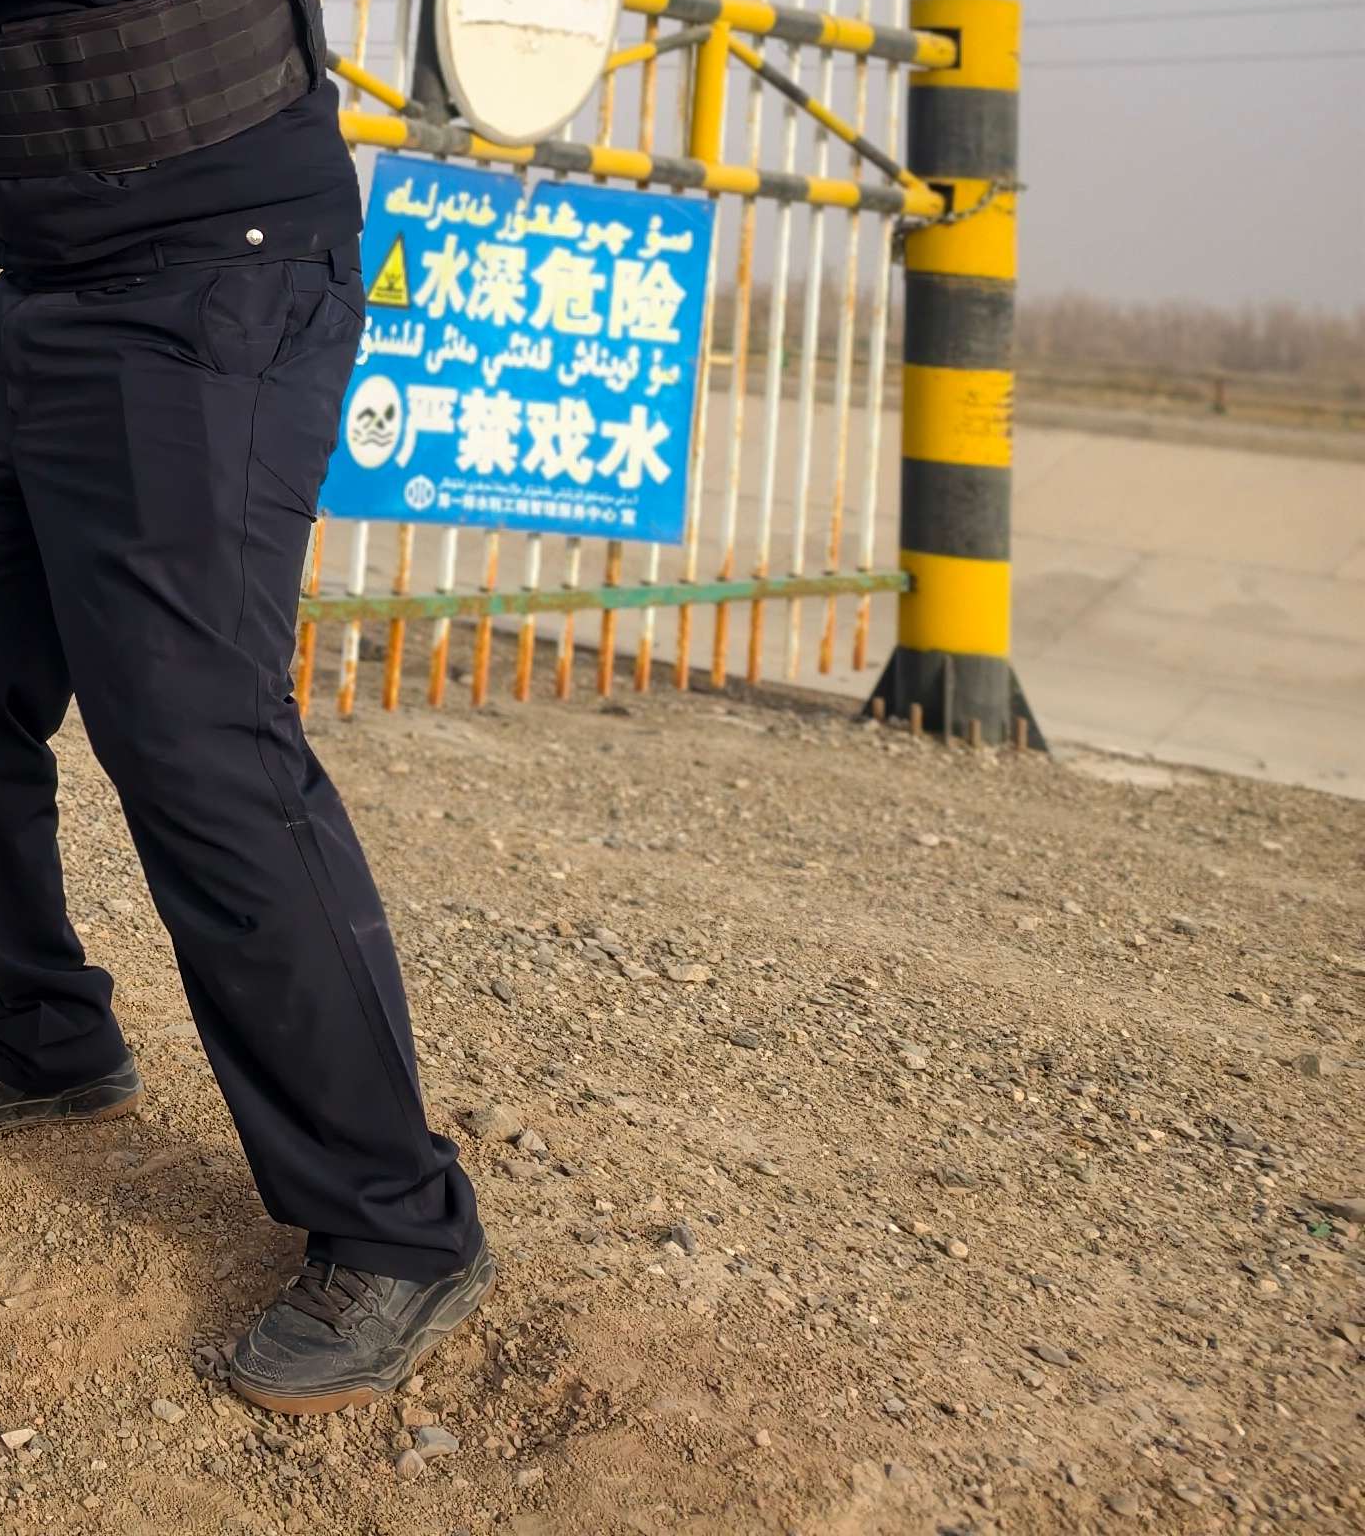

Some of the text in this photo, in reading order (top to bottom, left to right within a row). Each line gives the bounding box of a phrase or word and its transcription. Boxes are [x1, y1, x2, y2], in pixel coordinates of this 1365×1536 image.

[413, 234, 686, 343] 水深危险
[395, 383, 671, 489] 严禁戏水
